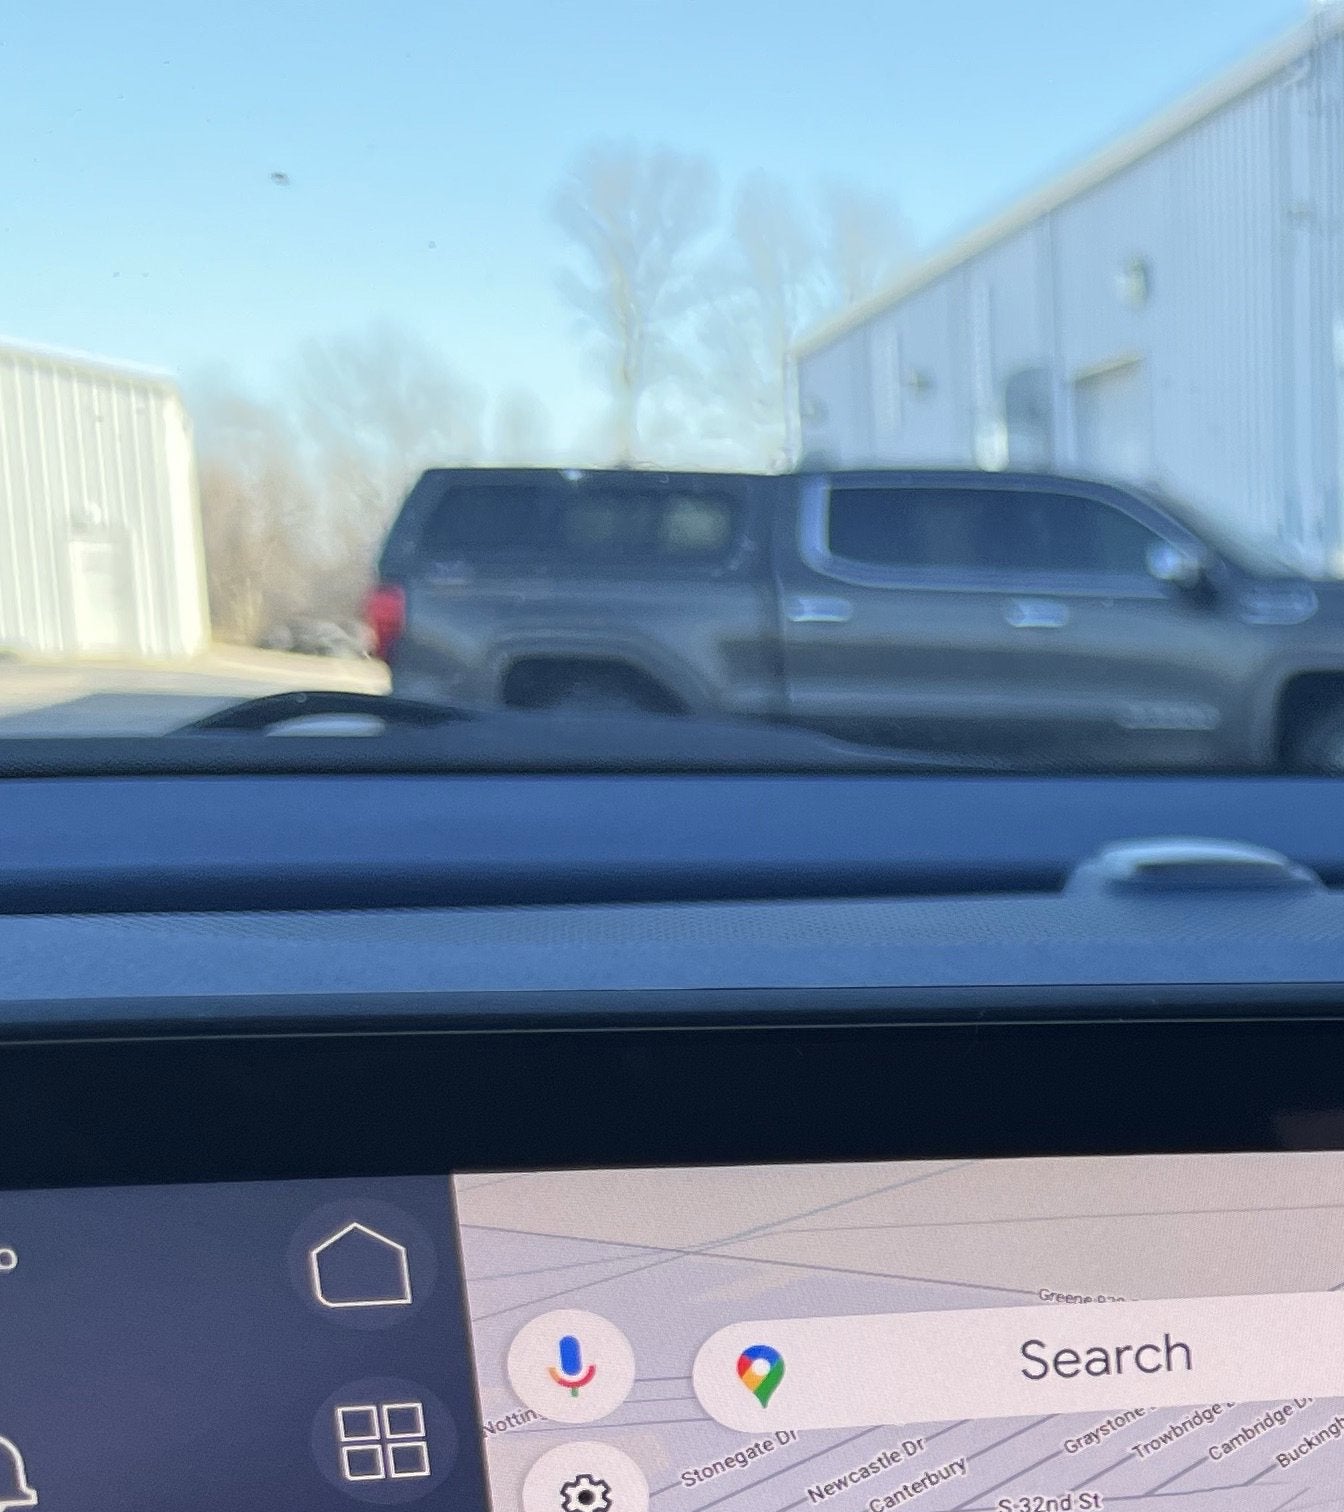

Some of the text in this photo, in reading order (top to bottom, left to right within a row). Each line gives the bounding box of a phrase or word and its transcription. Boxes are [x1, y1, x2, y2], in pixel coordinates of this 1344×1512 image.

[1020, 1333, 1192, 1380] Search
[483, 1408, 548, 1438] Nottin
[1063, 1407, 1146, 1454] Graystone
[1131, 1403, 1223, 1458] Trowbridge
[1208, 1405, 1294, 1461] Cambridge
[681, 1439, 775, 1488] Stonegate
[807, 1437, 926, 1504] Newcastle Dr
[1078, 1492, 1102, 1511] St
